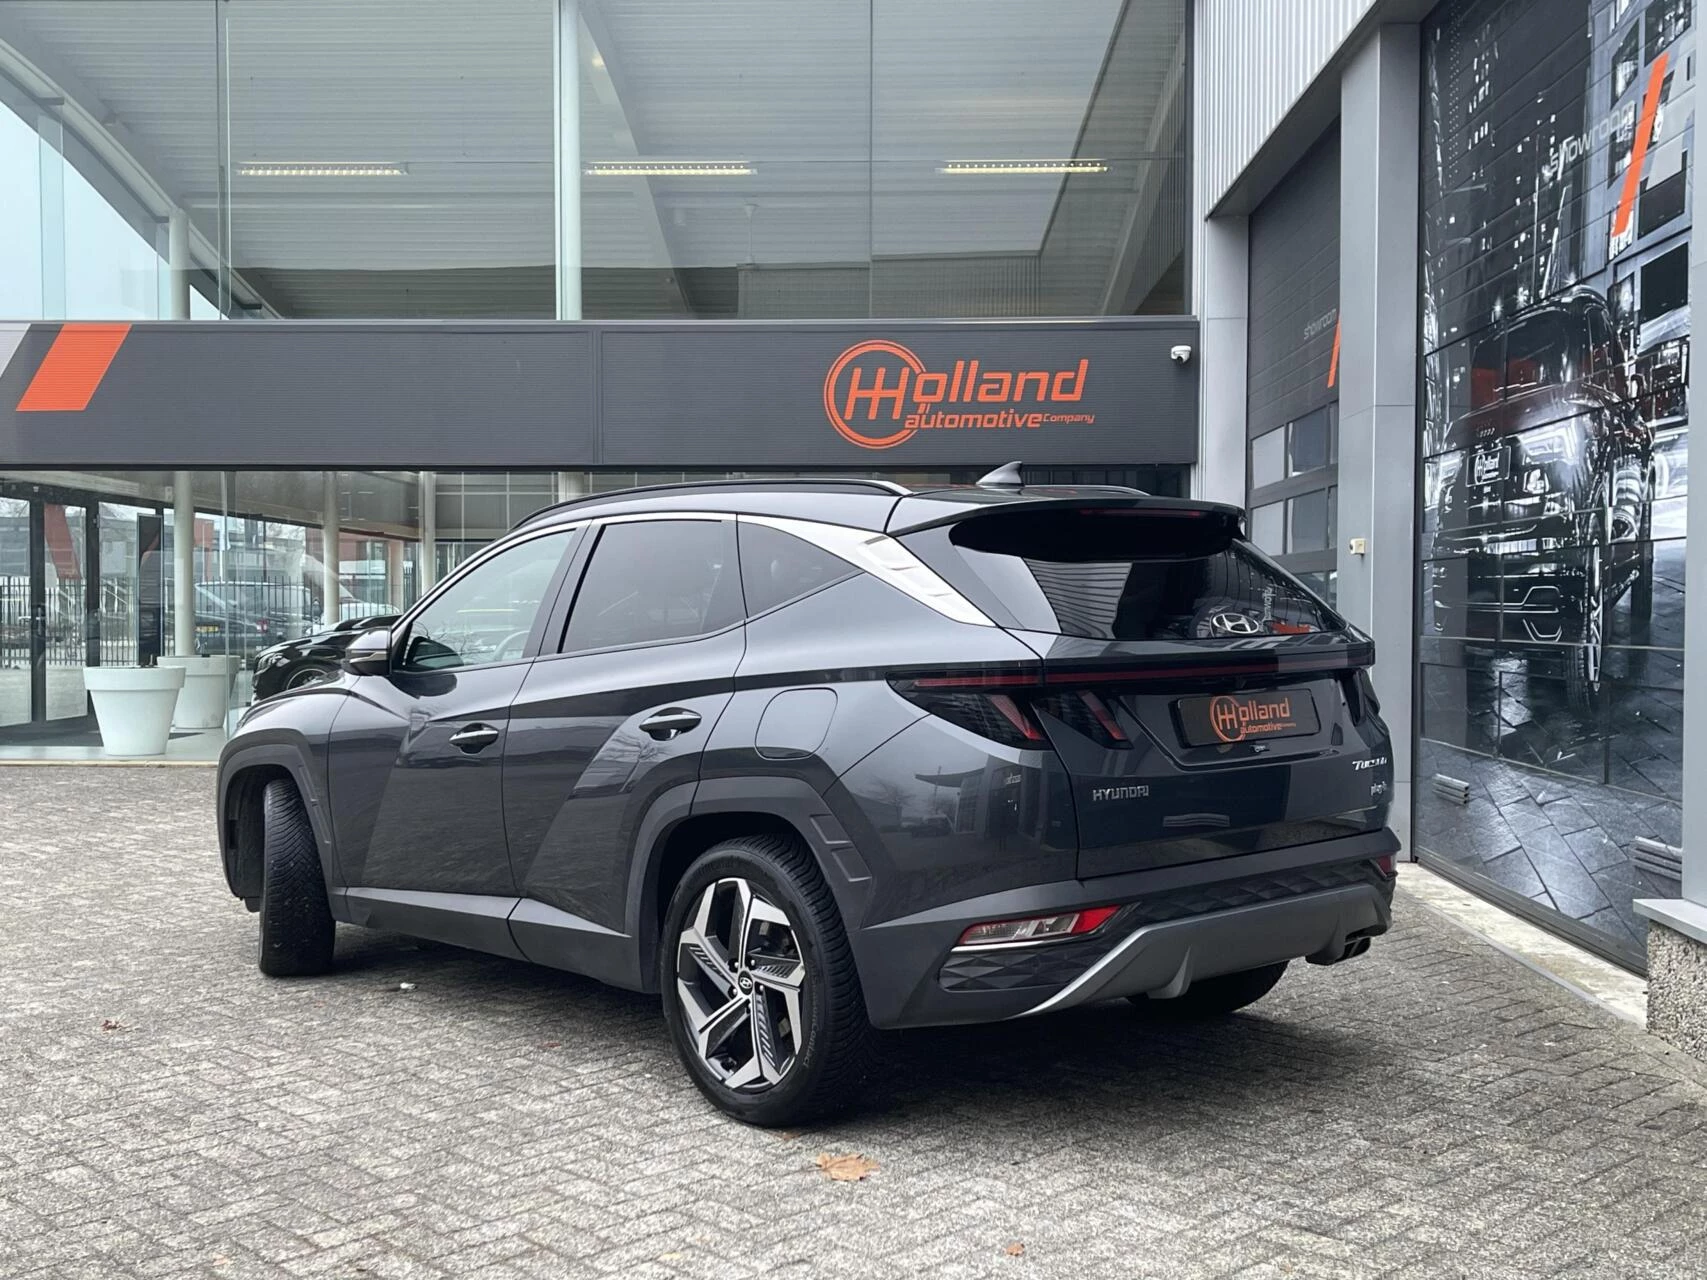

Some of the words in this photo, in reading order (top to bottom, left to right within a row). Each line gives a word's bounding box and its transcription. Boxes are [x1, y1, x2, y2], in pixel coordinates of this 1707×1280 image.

[1550, 100, 1635, 173] showroom
[844, 359, 1089, 420] Holland
[904, 408, 1042, 429] automotive
[1043, 413, 1095, 425] Company
[1216, 697, 1291, 730] Holland
[1240, 721, 1282, 734] automotive
[1092, 785, 1149, 801] HYUNDAI
